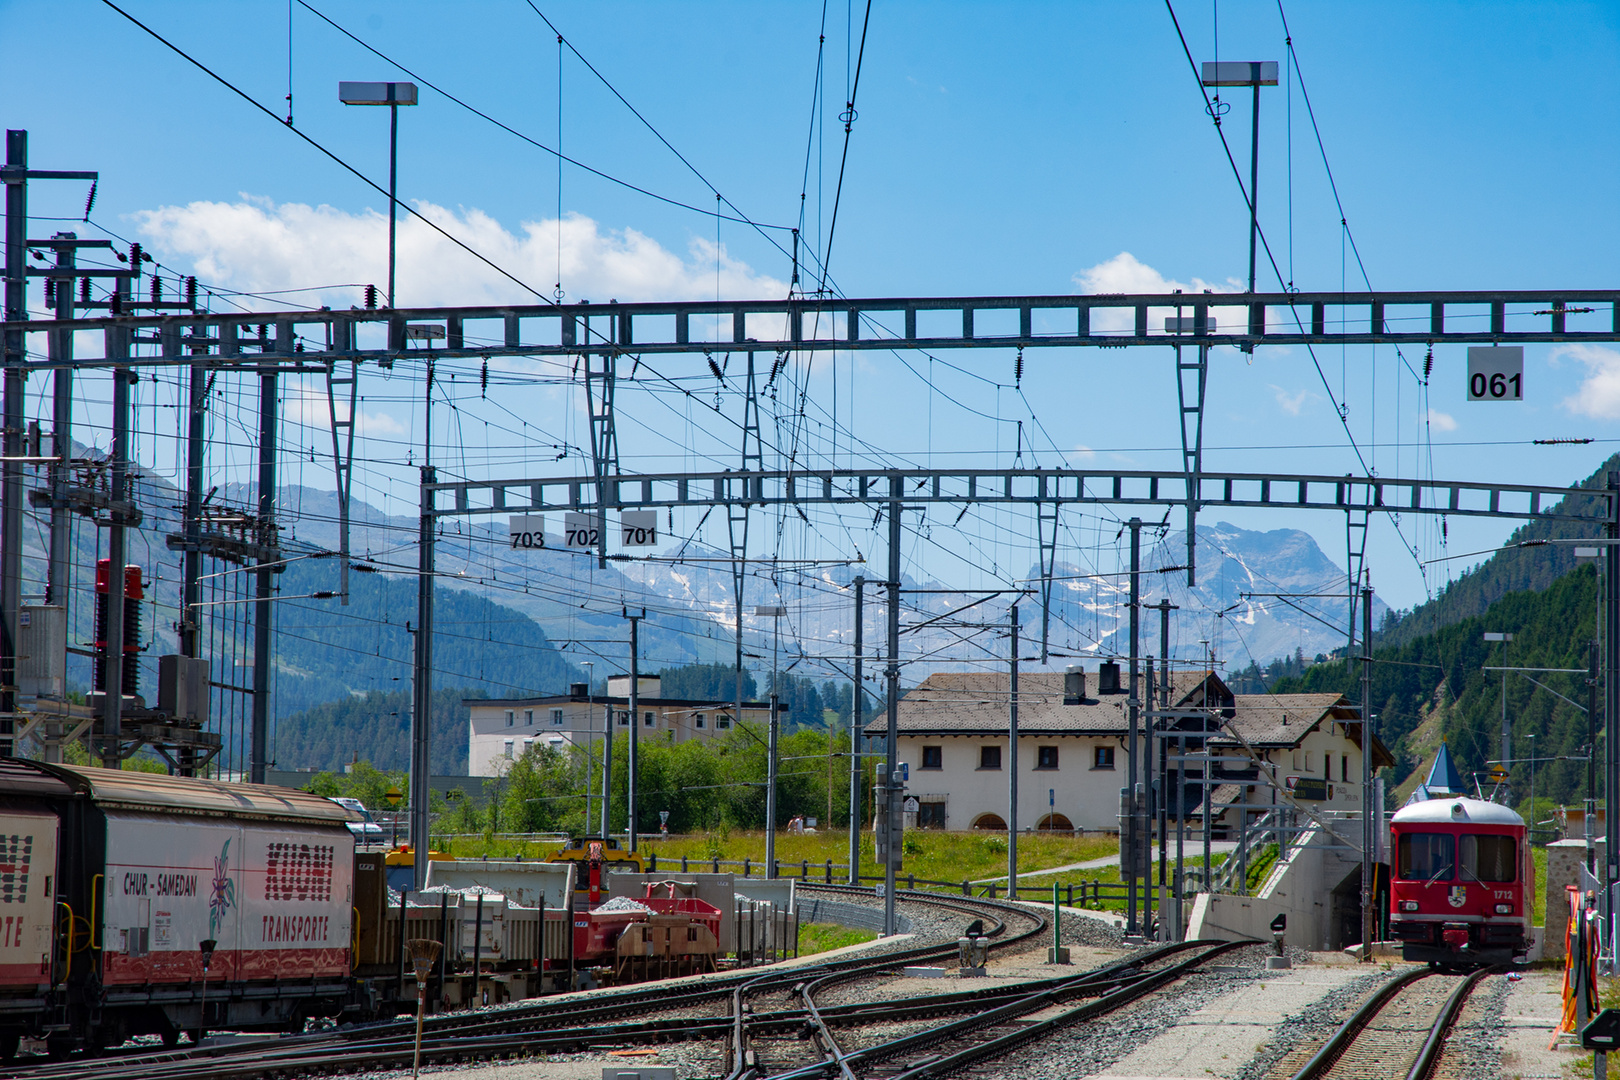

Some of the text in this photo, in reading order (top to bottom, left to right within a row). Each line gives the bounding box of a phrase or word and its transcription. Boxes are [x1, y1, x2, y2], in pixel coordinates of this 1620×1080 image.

[1470, 372, 1522, 398] 061
[510, 532, 545, 548] 703
[565, 529, 598, 546] 702
[623, 527, 656, 544] 701
[123, 872, 148, 896] CHUR
[157, 873, 198, 897] SAMEDAN
[1494, 890, 1513, 900] 1712
[262, 915, 329, 942] TRANSPORTE
